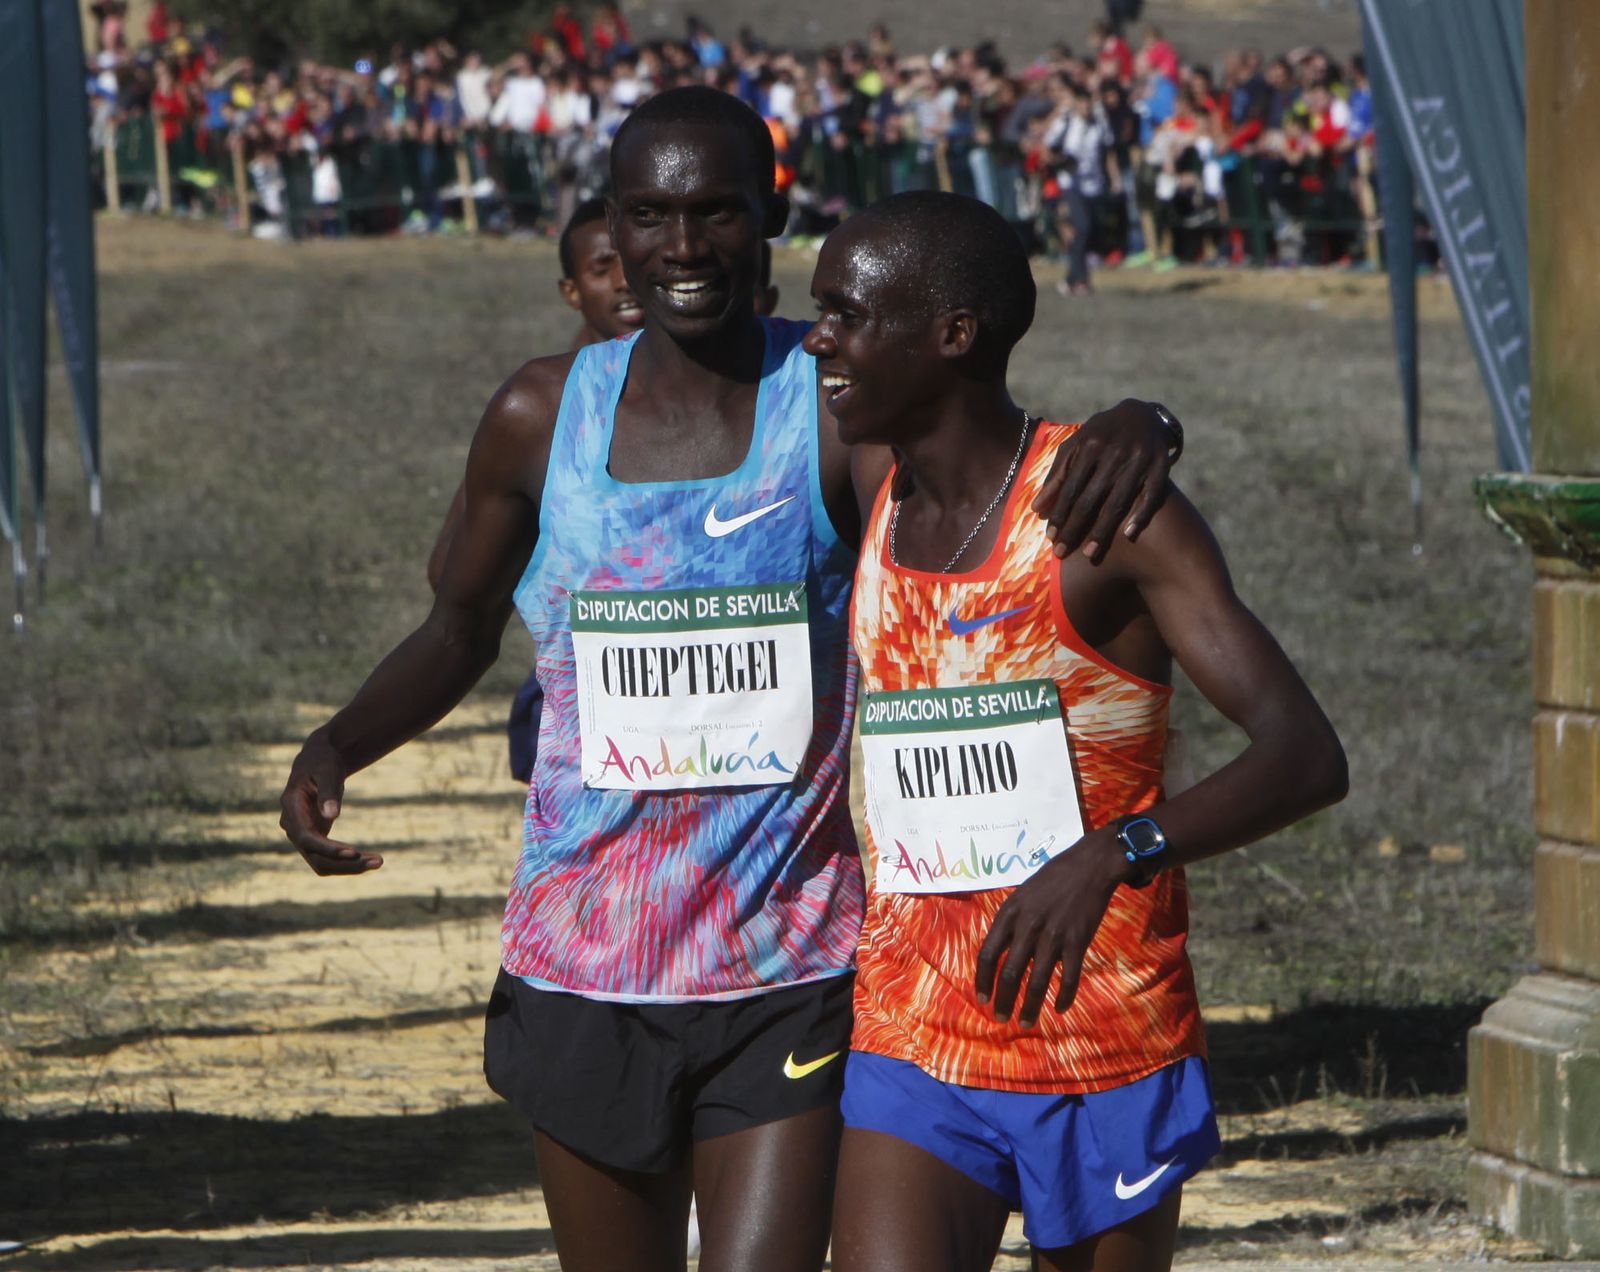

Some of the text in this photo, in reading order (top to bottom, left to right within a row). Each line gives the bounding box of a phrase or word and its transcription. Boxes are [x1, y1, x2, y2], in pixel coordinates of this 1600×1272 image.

[578, 590, 799, 621] DIPUTACION DE SEVILLA
[601, 639, 780, 698] CHEPTEGEI
[865, 686, 1051, 723] DIPUTACION DE SEVILLA
[690, 722, 723, 732] DORSAL
[598, 730, 794, 783] Andalucía
[894, 740, 1018, 799] KIPLIMO
[960, 823, 990, 833] DORSAL
